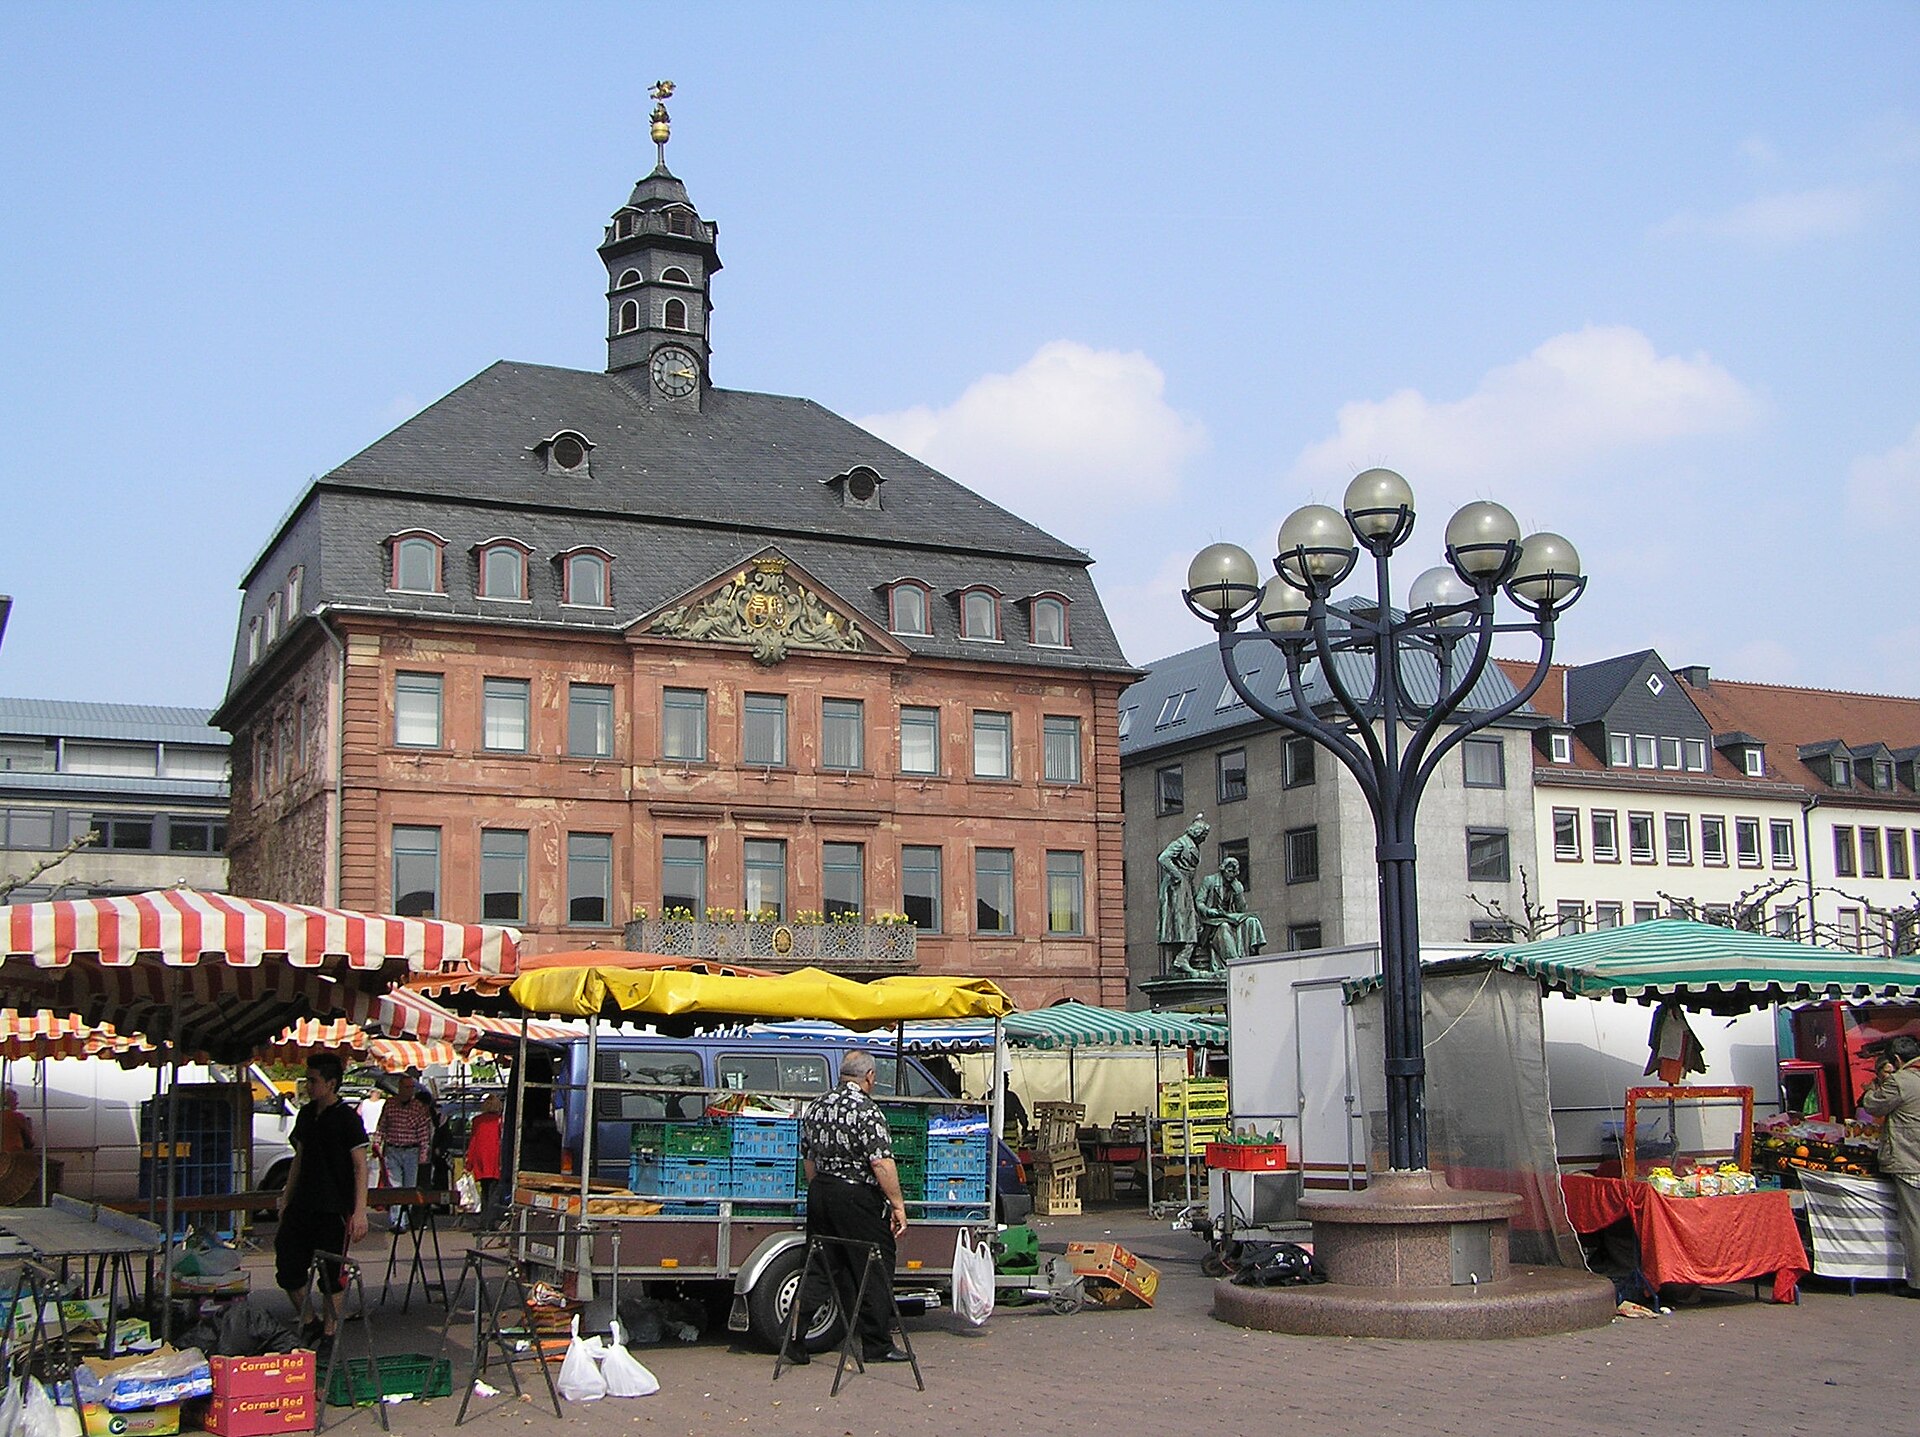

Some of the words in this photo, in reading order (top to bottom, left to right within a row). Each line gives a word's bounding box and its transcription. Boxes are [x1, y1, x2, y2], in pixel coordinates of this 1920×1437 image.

[240, 1359, 280, 1371] Carmel
[283, 1357, 304, 1368] Red
[239, 1398, 280, 1411] Carmel
[282, 1396, 304, 1408] Red
